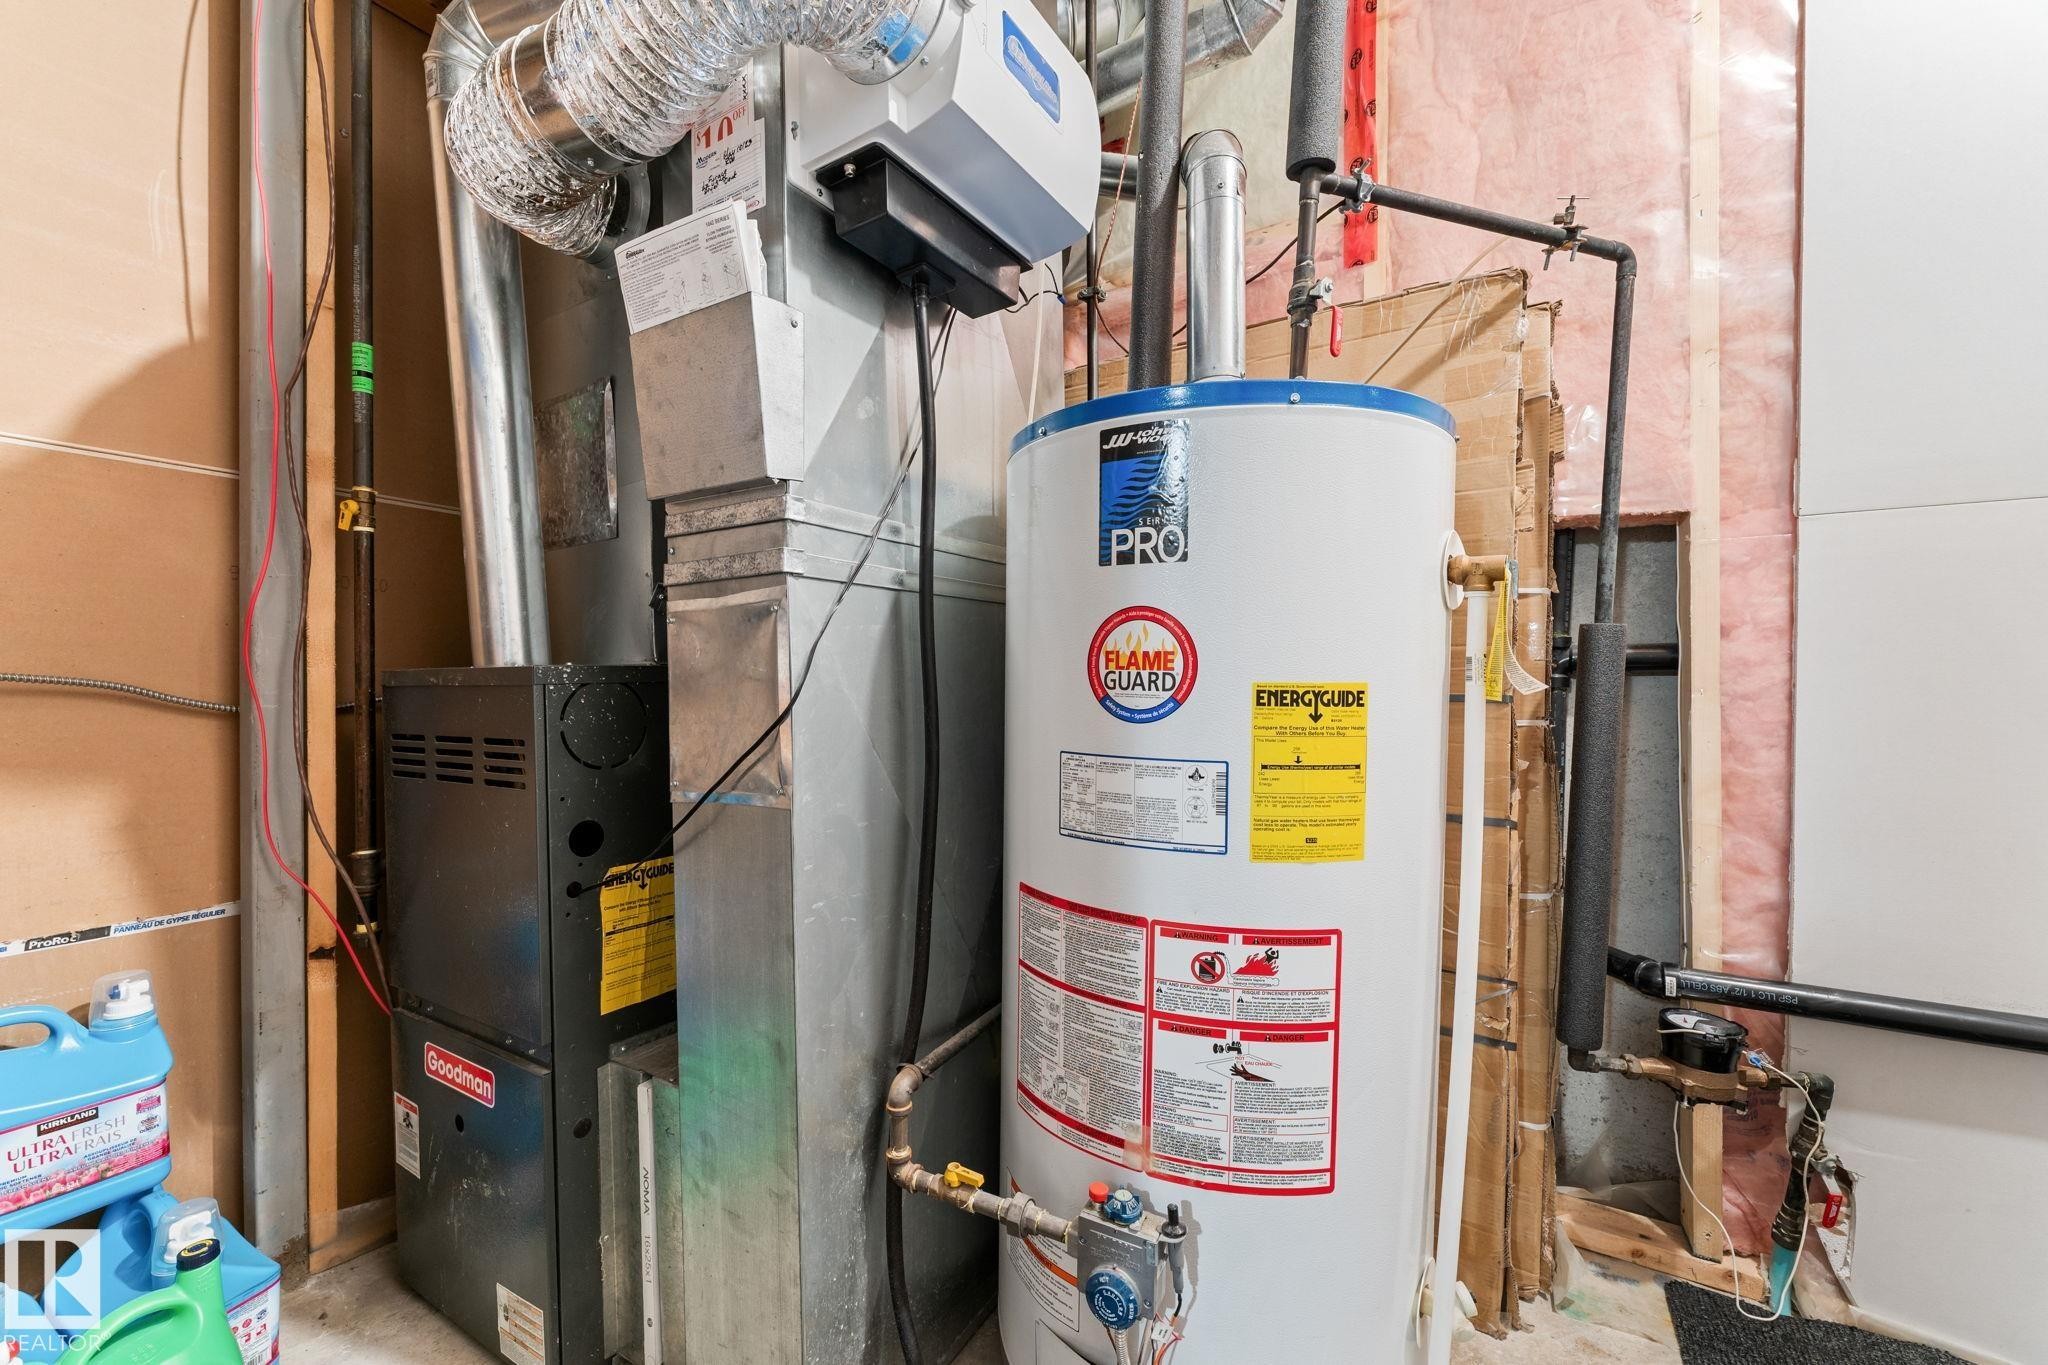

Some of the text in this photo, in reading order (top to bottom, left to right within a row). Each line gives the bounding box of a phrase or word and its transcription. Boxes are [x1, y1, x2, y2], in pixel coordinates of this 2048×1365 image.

[1112, 525, 1185, 566] PRO
[1104, 650, 1175, 671] FLAME
[1104, 671, 1176, 692] GUARD
[1256, 689, 1365, 708] ENERGYGUIDE
[1253, 724, 1281, 732] Compare
[113, 921, 153, 934] PANNEAU
[153, 919, 165, 927] DE
[166, 914, 190, 925] GYPSE
[191, 908, 226, 920] RÉGULIER
[1181, 932, 1218, 942] WARNING
[1180, 983, 1208, 991] EXPLOSION
[1710, 984, 1729, 994] ABS
[1758, 991, 1776, 1000] LLC
[1179, 1026, 1305, 1042] DANGER DANGER
[427, 1050, 492, 1100] Goodman
[40, 1108, 97, 1131] KIRKLAND
[7, 1134, 67, 1162] ULTRA
[72, 1114, 126, 1142] FRESH
[13, 1129, 122, 1174] ULTRA FRAIS
[84, 1140, 129, 1158] ASSOUPLISSEUR
